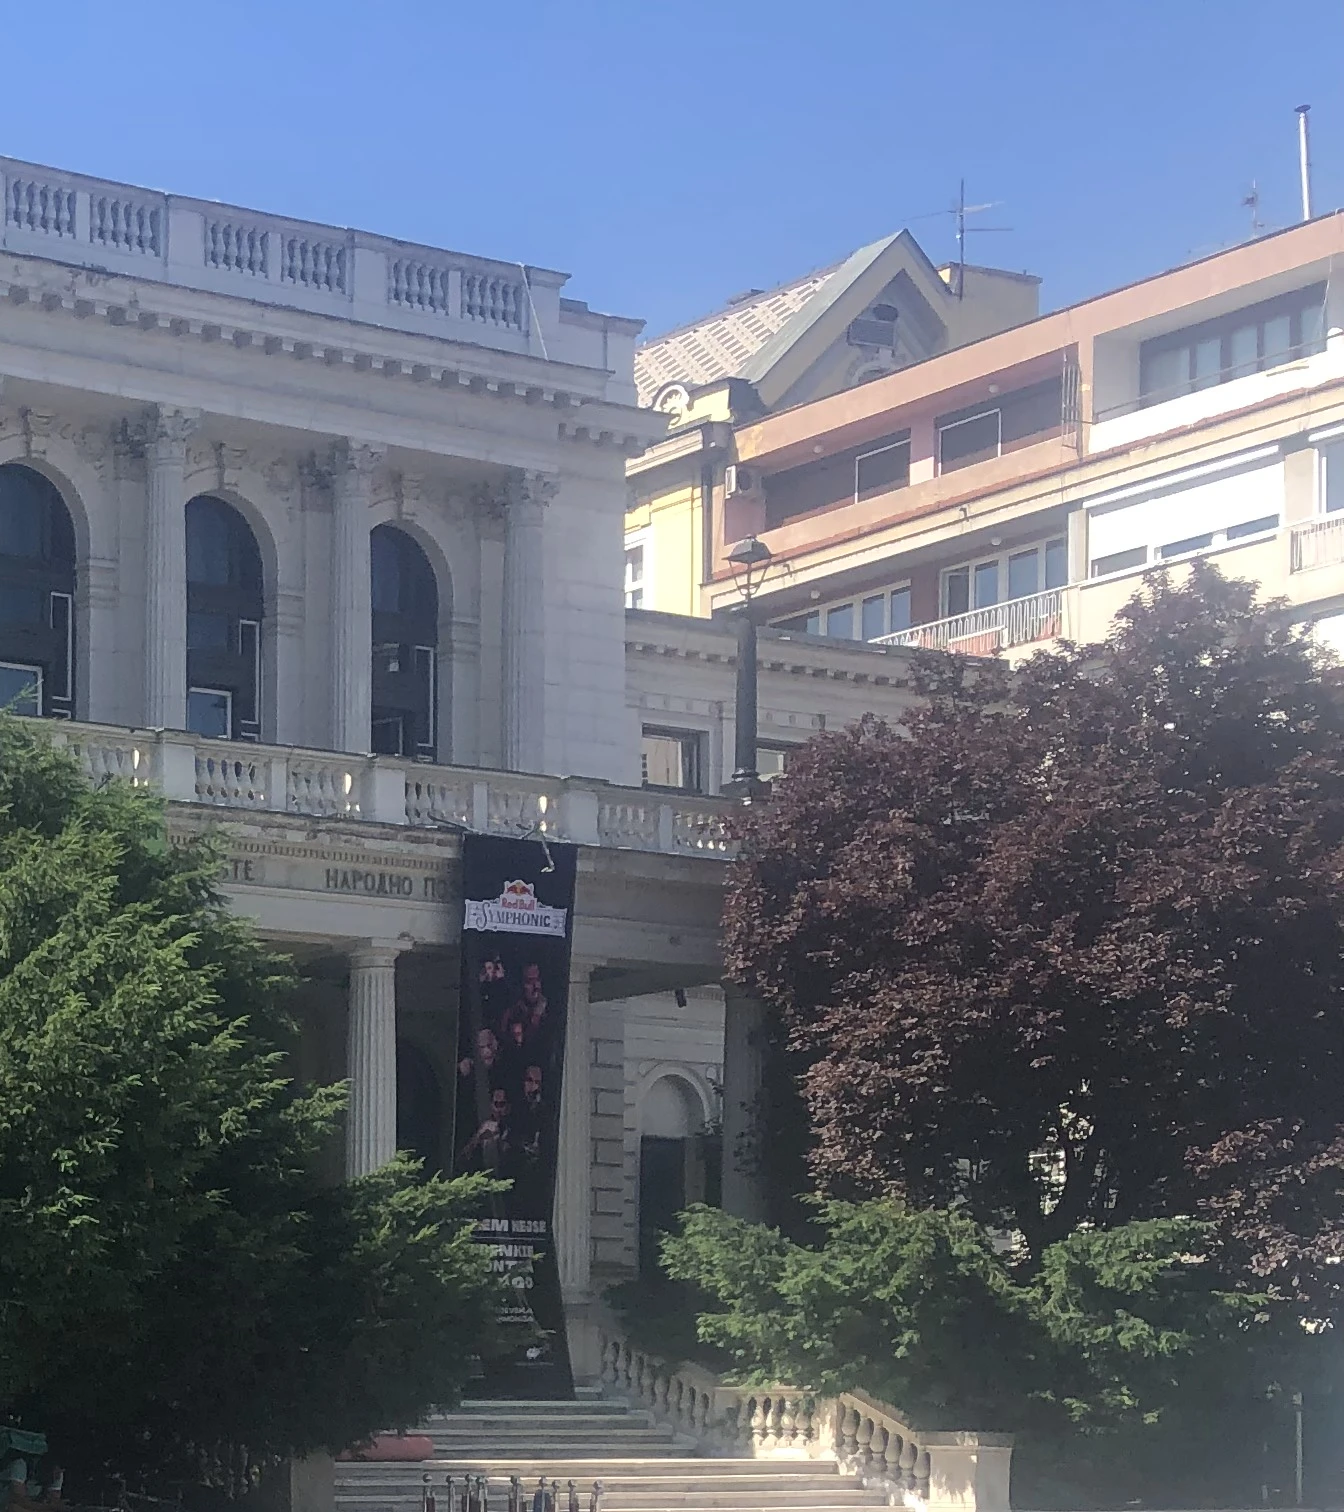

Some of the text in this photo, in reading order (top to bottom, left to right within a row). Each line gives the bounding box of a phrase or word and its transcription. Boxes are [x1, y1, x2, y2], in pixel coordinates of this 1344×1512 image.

[325, 867, 413, 897] НАРОДНО
[475, 902, 551, 929] SYMPHONIC
[501, 897, 535, 911] Red Bull
